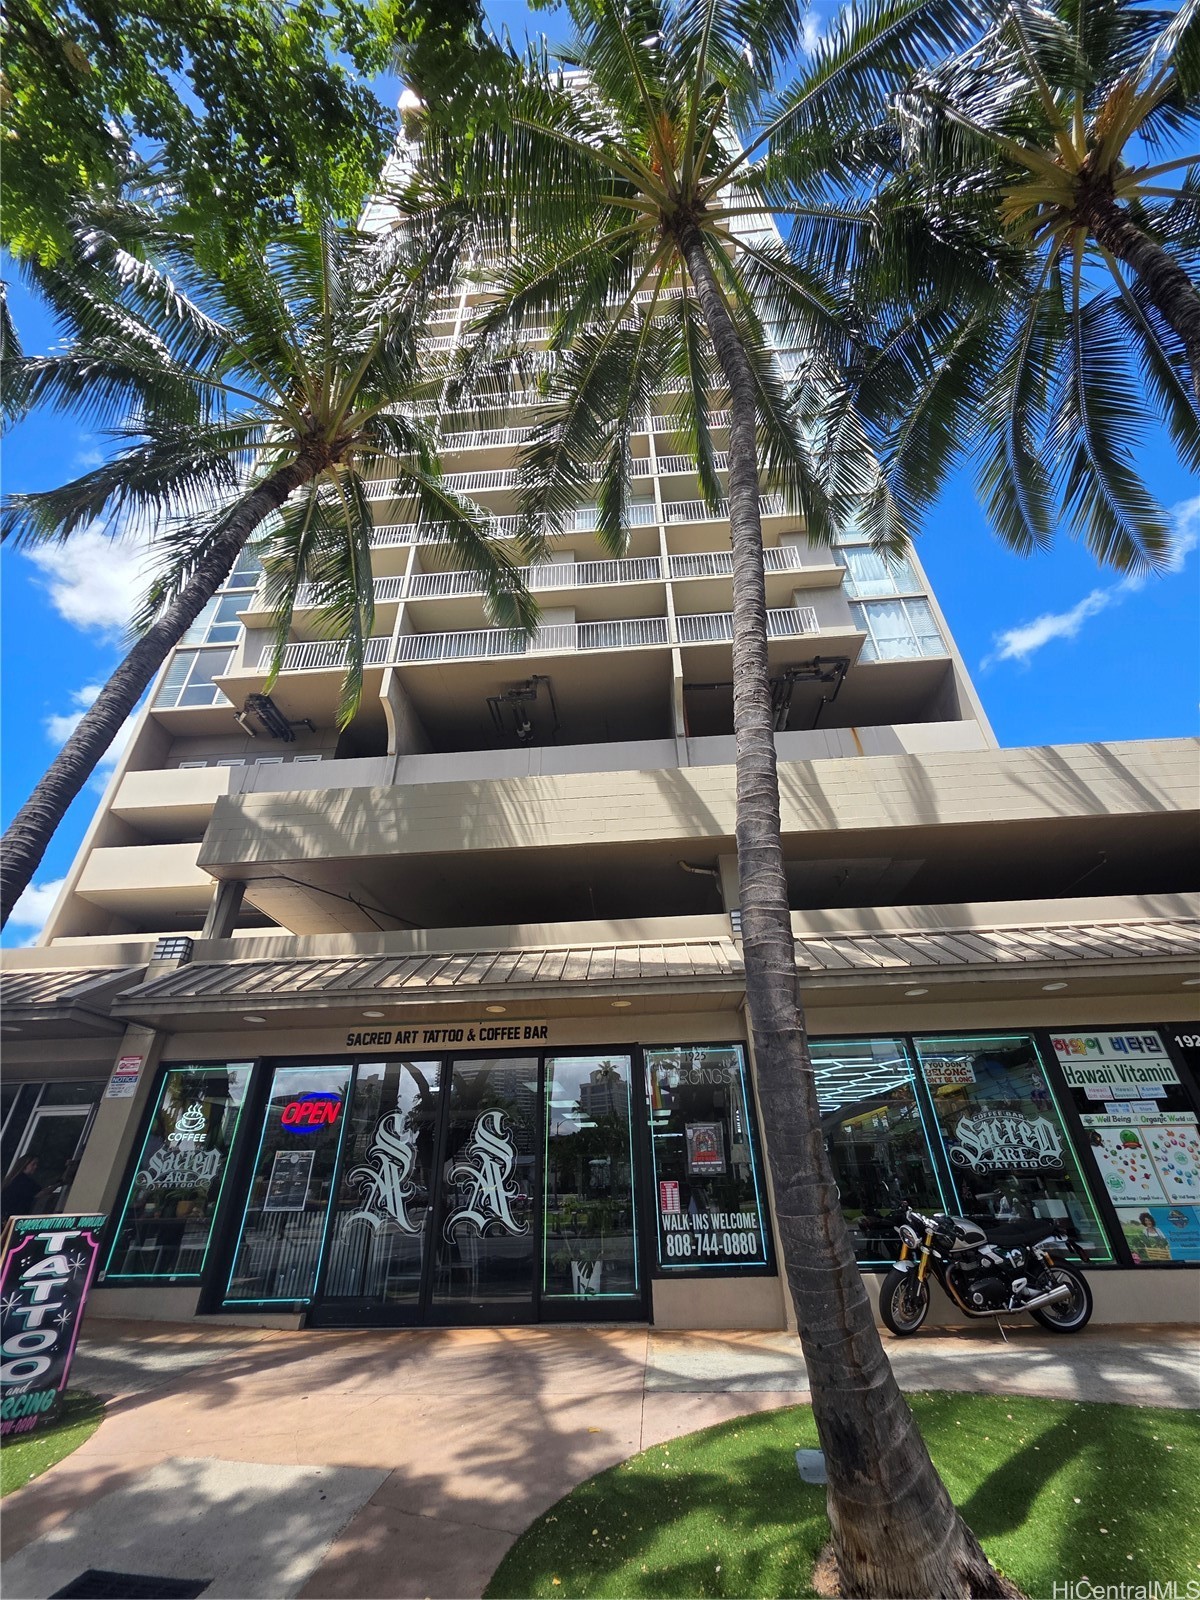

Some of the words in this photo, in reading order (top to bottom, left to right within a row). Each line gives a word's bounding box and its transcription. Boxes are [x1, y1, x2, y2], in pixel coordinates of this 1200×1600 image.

[346, 1031, 392, 1046] SACRED
[394, 1030, 419, 1044] ART
[422, 1029, 464, 1043] TATTOO
[467, 1029, 476, 1041] &
[479, 1027, 521, 1041] COFFEE
[523, 1026, 548, 1039] BAR
[684, 1052, 706, 1061] 1925
[1063, 1065, 1116, 1084] Hawaii
[1114, 1064, 1175, 1083] Vitamin
[281, 1102, 341, 1124] OPEN
[973, 1110, 1001, 1121] COFFEE
[1005, 1111, 1024, 1119] BAR
[1112, 1115, 1131, 1123] Being
[1140, 1114, 1167, 1124] Organic
[168, 1133, 207, 1142] COFFEE
[993, 1147, 1026, 1160] ART
[164, 1171, 191, 1182] ART
[662, 1213, 709, 1231] WALK-INS
[711, 1212, 757, 1230] WELCOME
[666, 1232, 757, 1257] 808-744-0880
[1005, 1249, 1025, 1268] 12
[0, 1231, 81, 1384] TATTOO
[5, 1380, 33, 1396] and
[0, 1389, 56, 1419] RCING
